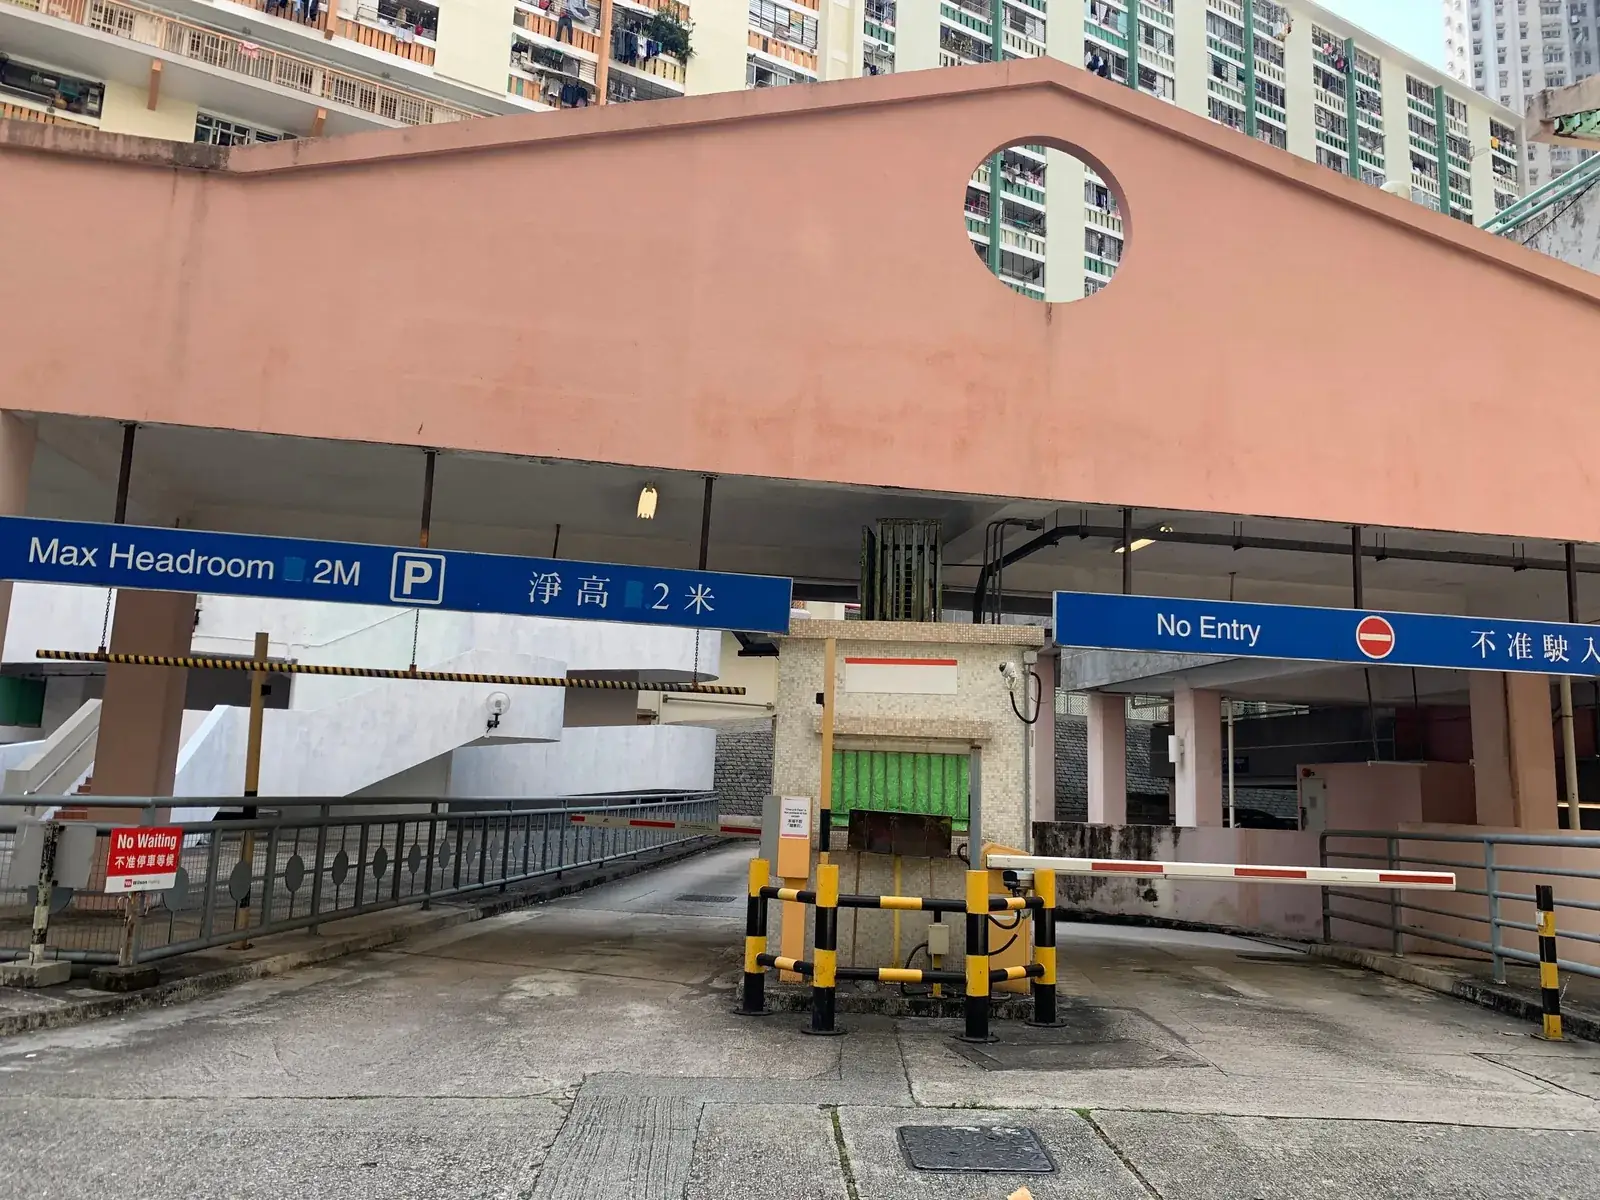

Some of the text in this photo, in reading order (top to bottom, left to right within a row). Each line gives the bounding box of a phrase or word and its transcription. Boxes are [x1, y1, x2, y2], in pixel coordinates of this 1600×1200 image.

[29, 536, 361, 586] Max Headroom 2M
[402, 560, 432, 594] P
[1157, 613, 1260, 647] No Entry
[1470, 629, 1600, 664] 不准駛入
[117, 833, 177, 850] No Waiting
[115, 854, 174, 869] 不准停車等候
